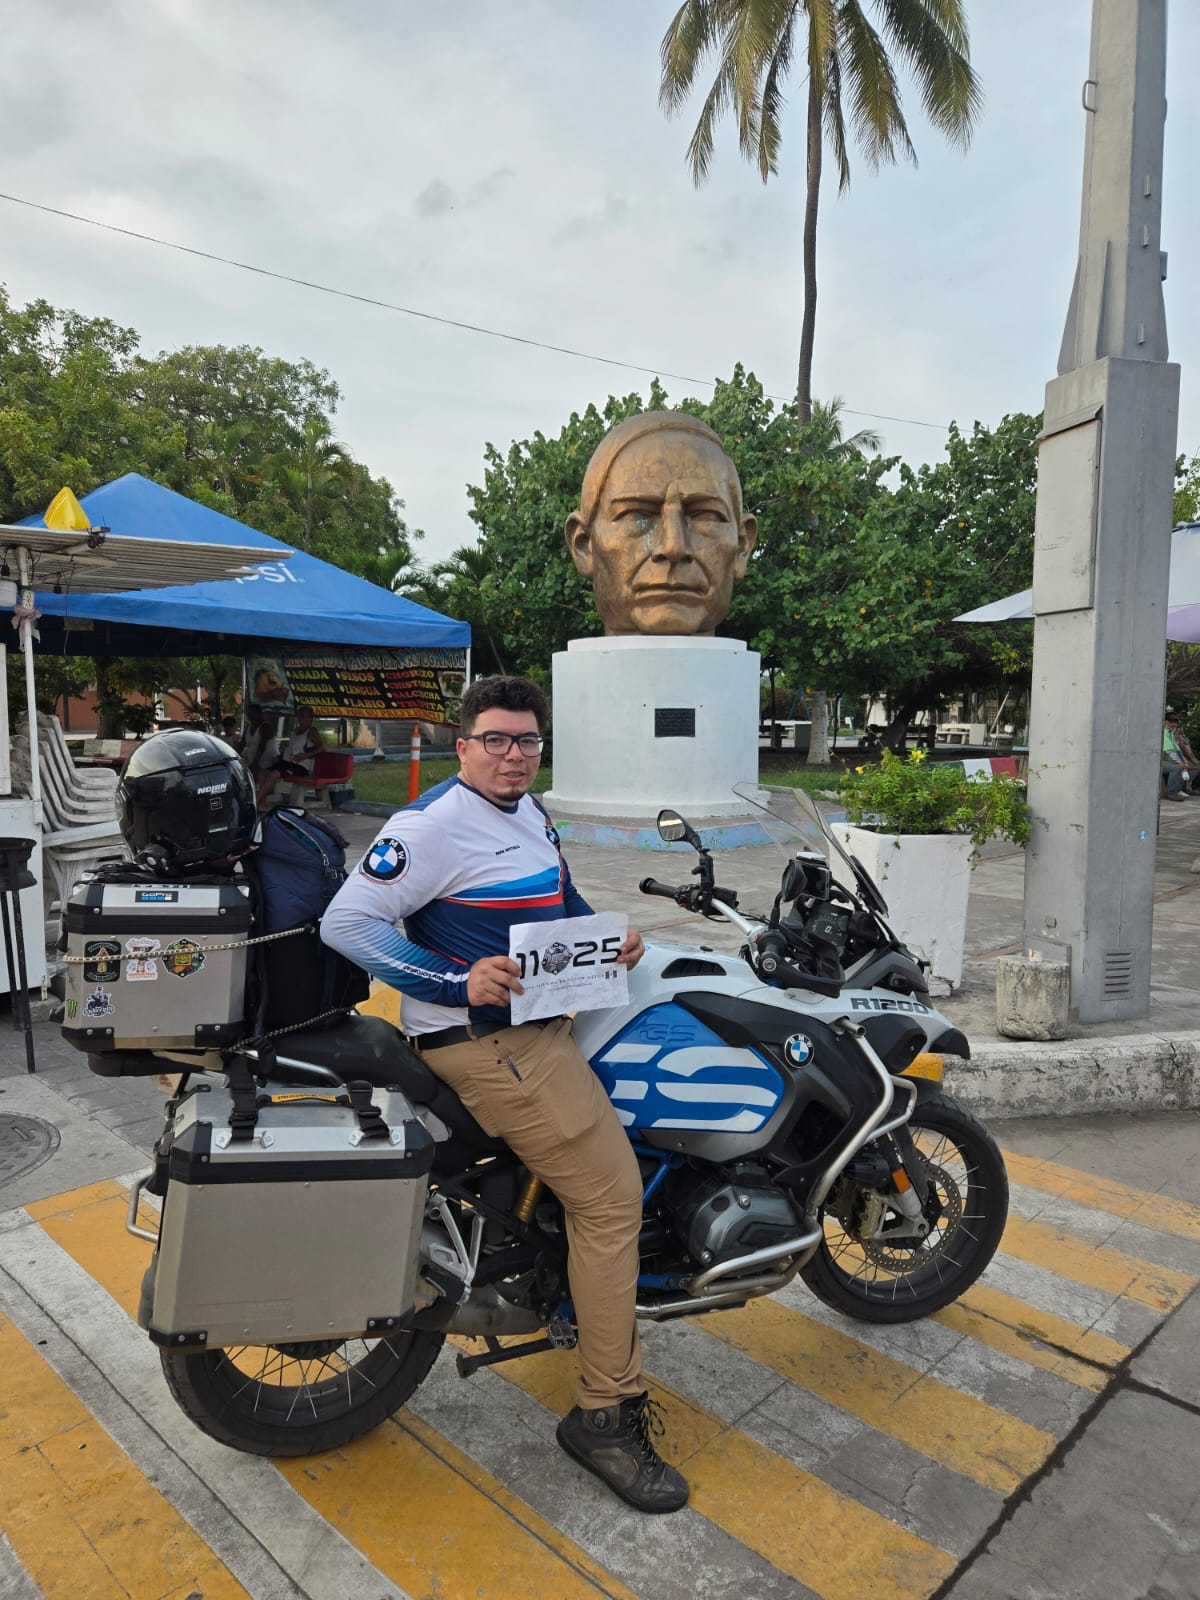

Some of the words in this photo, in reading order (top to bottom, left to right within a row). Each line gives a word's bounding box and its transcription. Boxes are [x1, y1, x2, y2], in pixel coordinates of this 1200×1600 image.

[291, 670, 330, 680] ASADA
[384, 669, 435, 680] CHORZO
[573, 937, 622, 967] 25
[850, 997, 929, 1015] R1200
